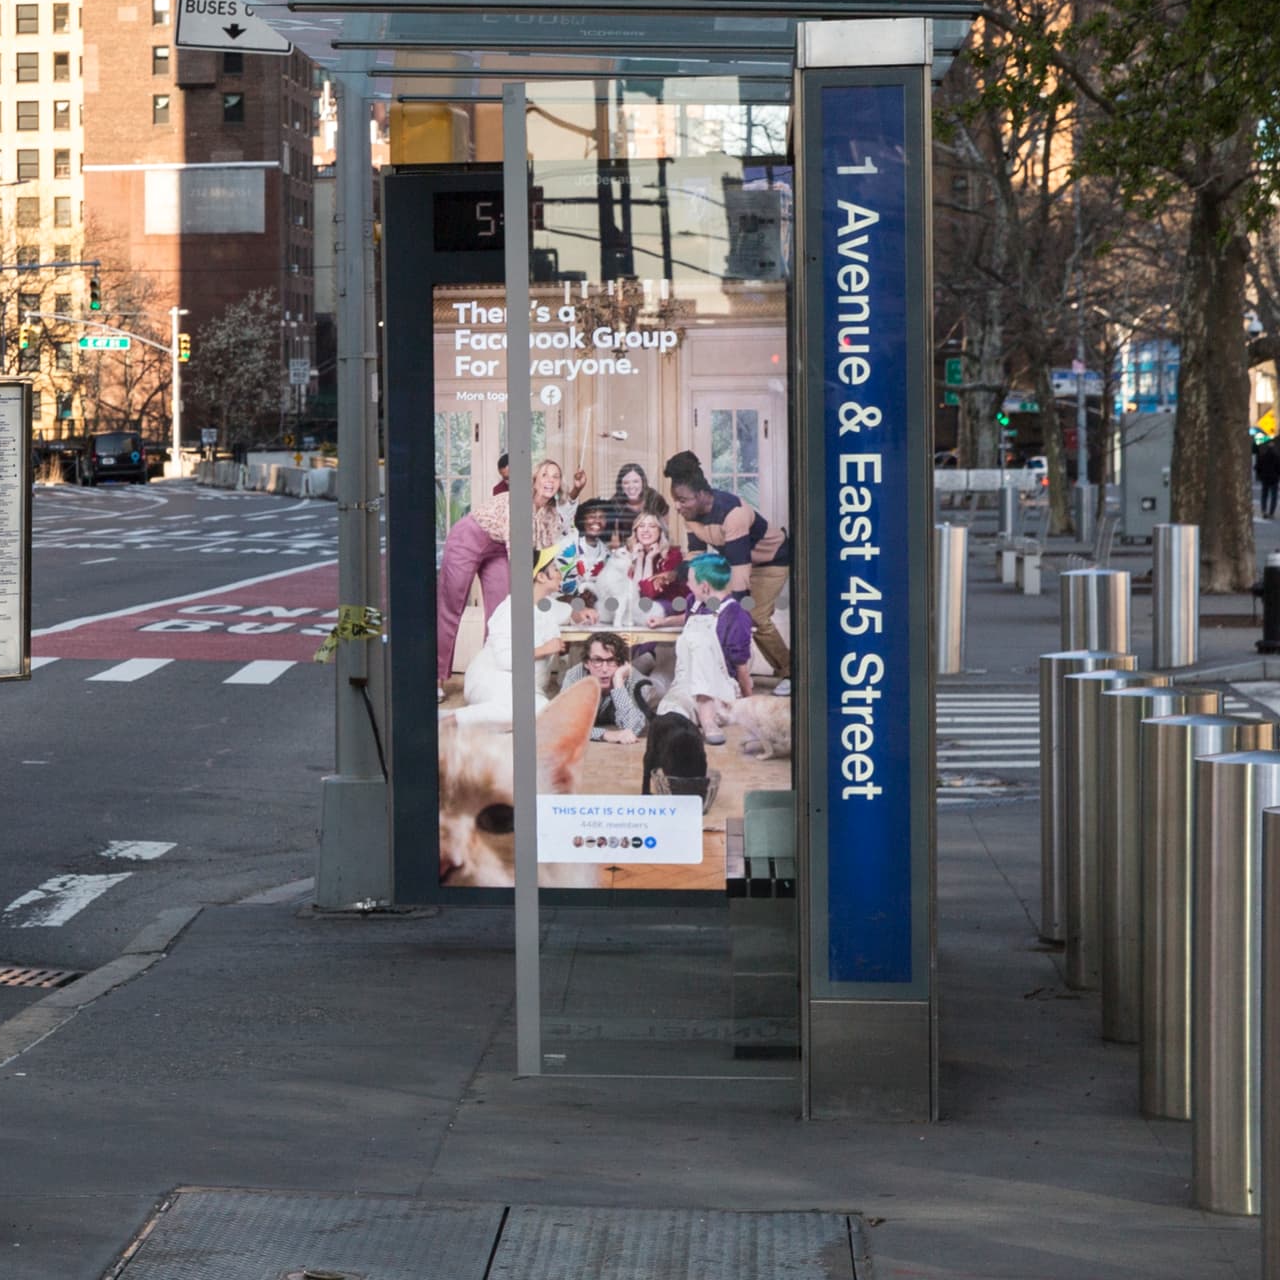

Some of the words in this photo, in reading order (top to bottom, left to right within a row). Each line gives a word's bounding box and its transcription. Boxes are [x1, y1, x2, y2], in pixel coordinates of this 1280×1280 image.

[185, 0, 237, 16] BUSES
[837, 156, 878, 175] 1
[837, 199, 880, 385] Avenue
[559, 306, 575, 323] a
[592, 326, 677, 353] Group
[455, 355, 499, 376] For
[529, 357, 639, 381] veryone.
[457, 391, 485, 401] More
[838, 401, 883, 437] &
[839, 453, 883, 560] East
[840, 576, 883, 636] 45
[840, 652, 885, 800] Street
[552, 807, 577, 816] THIS
[579, 807, 601, 816] CAT
[603, 807, 613, 816] IS
[606, 821, 648, 829] members
